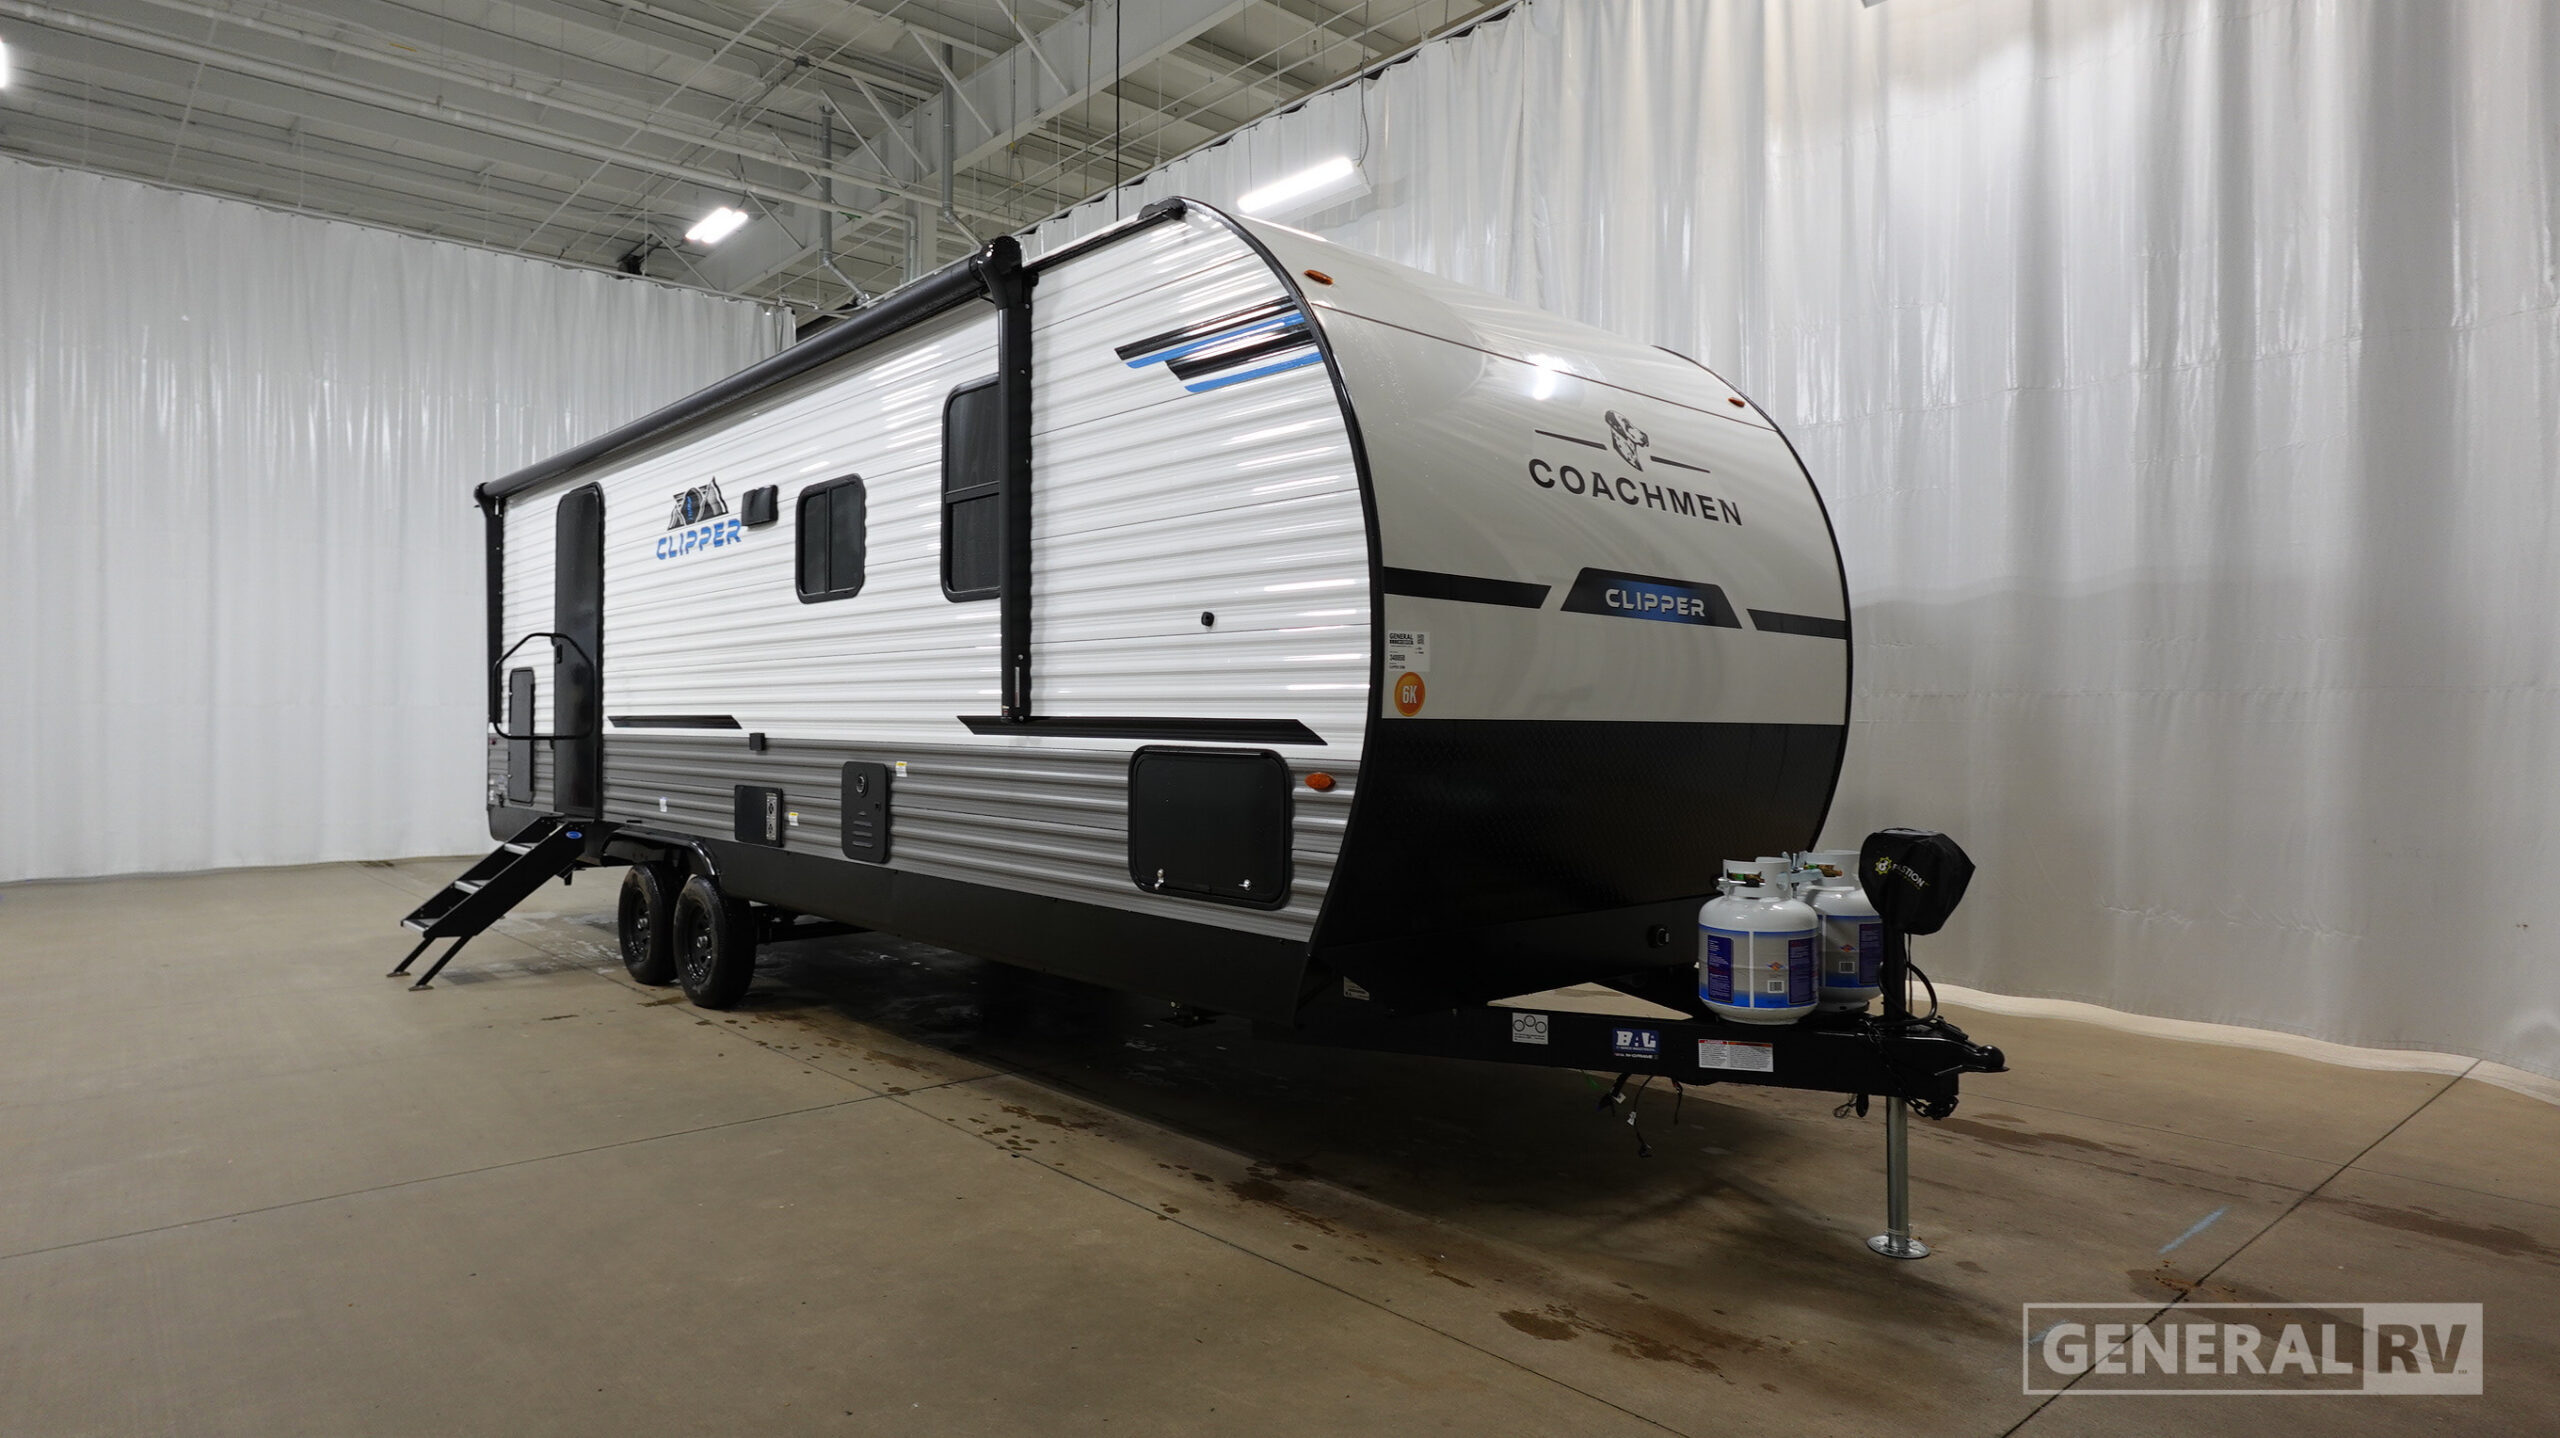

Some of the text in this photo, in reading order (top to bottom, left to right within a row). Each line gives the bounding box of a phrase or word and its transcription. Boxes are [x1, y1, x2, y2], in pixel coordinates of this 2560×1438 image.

[1528, 458, 1743, 526] COACHMEN
[656, 518, 742, 560] CLIPPER
[1605, 587, 1706, 618] CLIPPER
[1402, 685, 1417, 704] 6K
